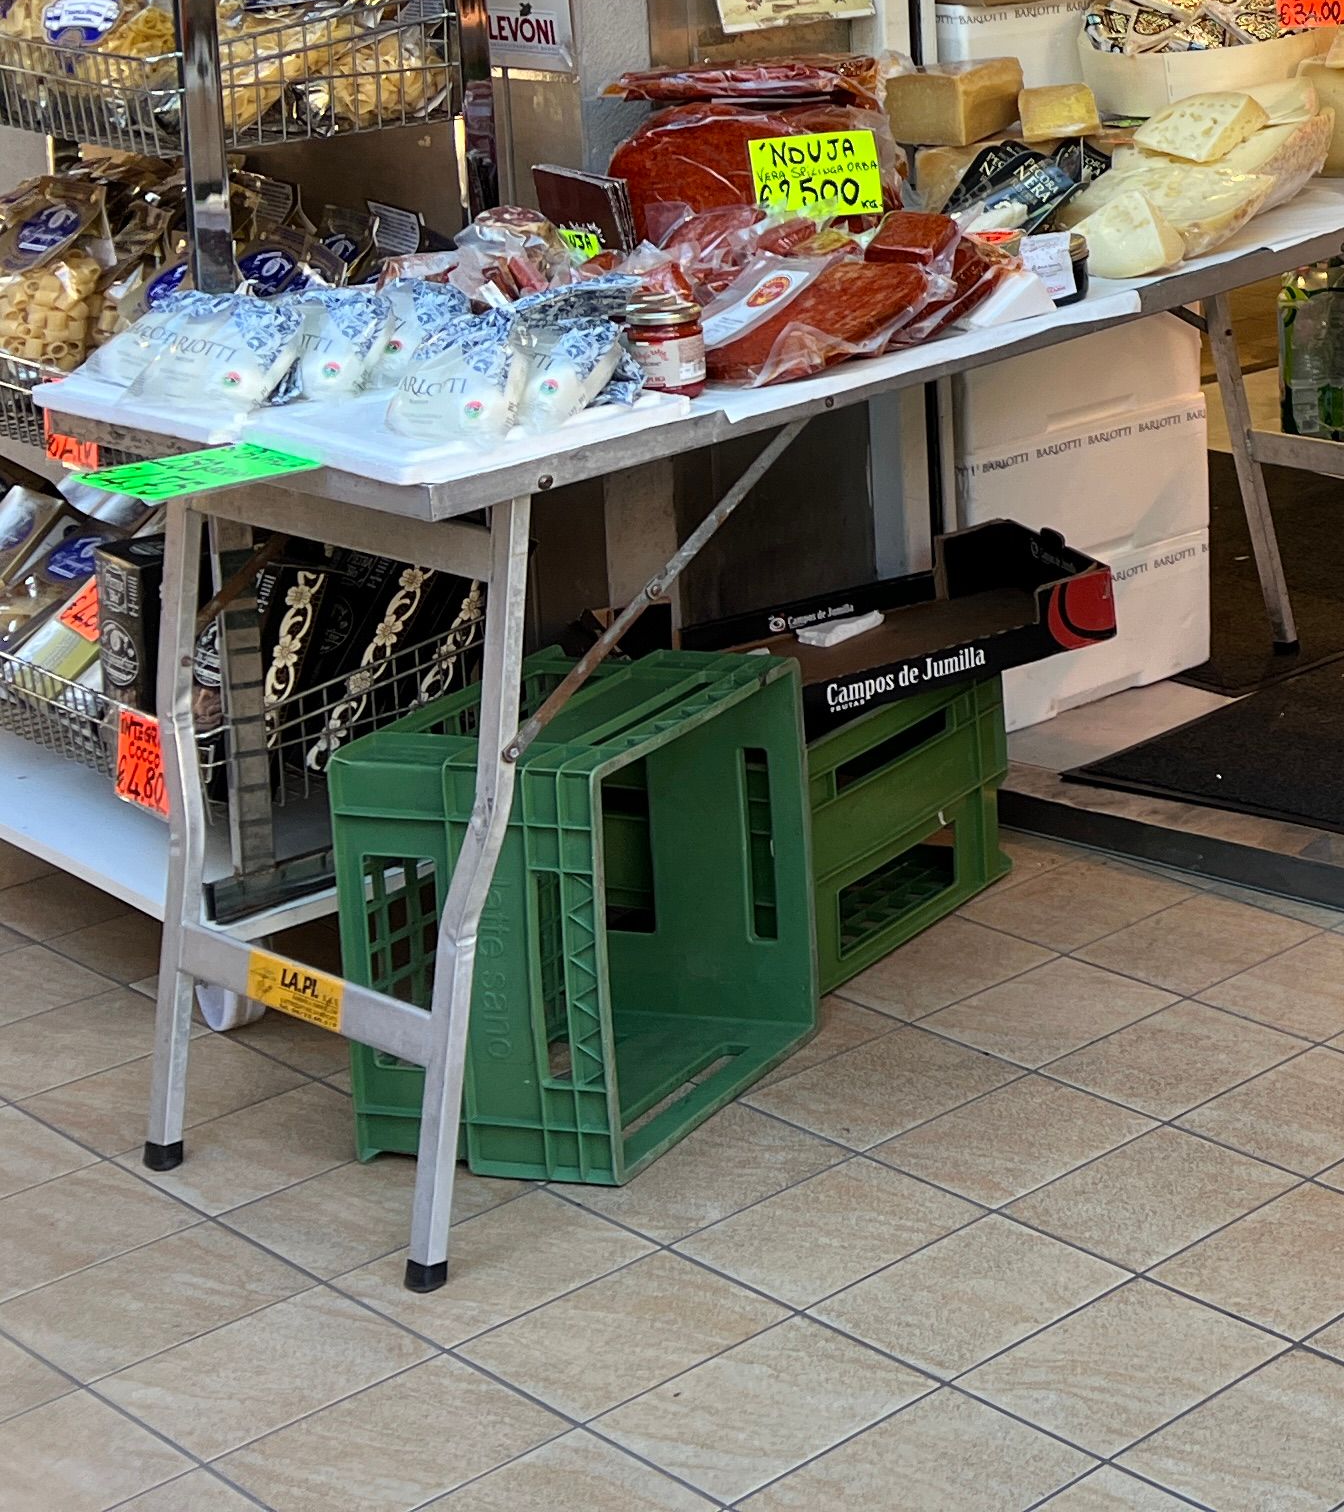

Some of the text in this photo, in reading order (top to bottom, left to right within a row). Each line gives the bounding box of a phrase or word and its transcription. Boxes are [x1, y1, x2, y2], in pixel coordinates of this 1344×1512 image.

[489, 15, 557, 46] LEVONI
[1013, 166, 1051, 203] NERA
[398, 376, 468, 399] ARLOTTI
[827, 646, 987, 709] Campos de Jumilla
